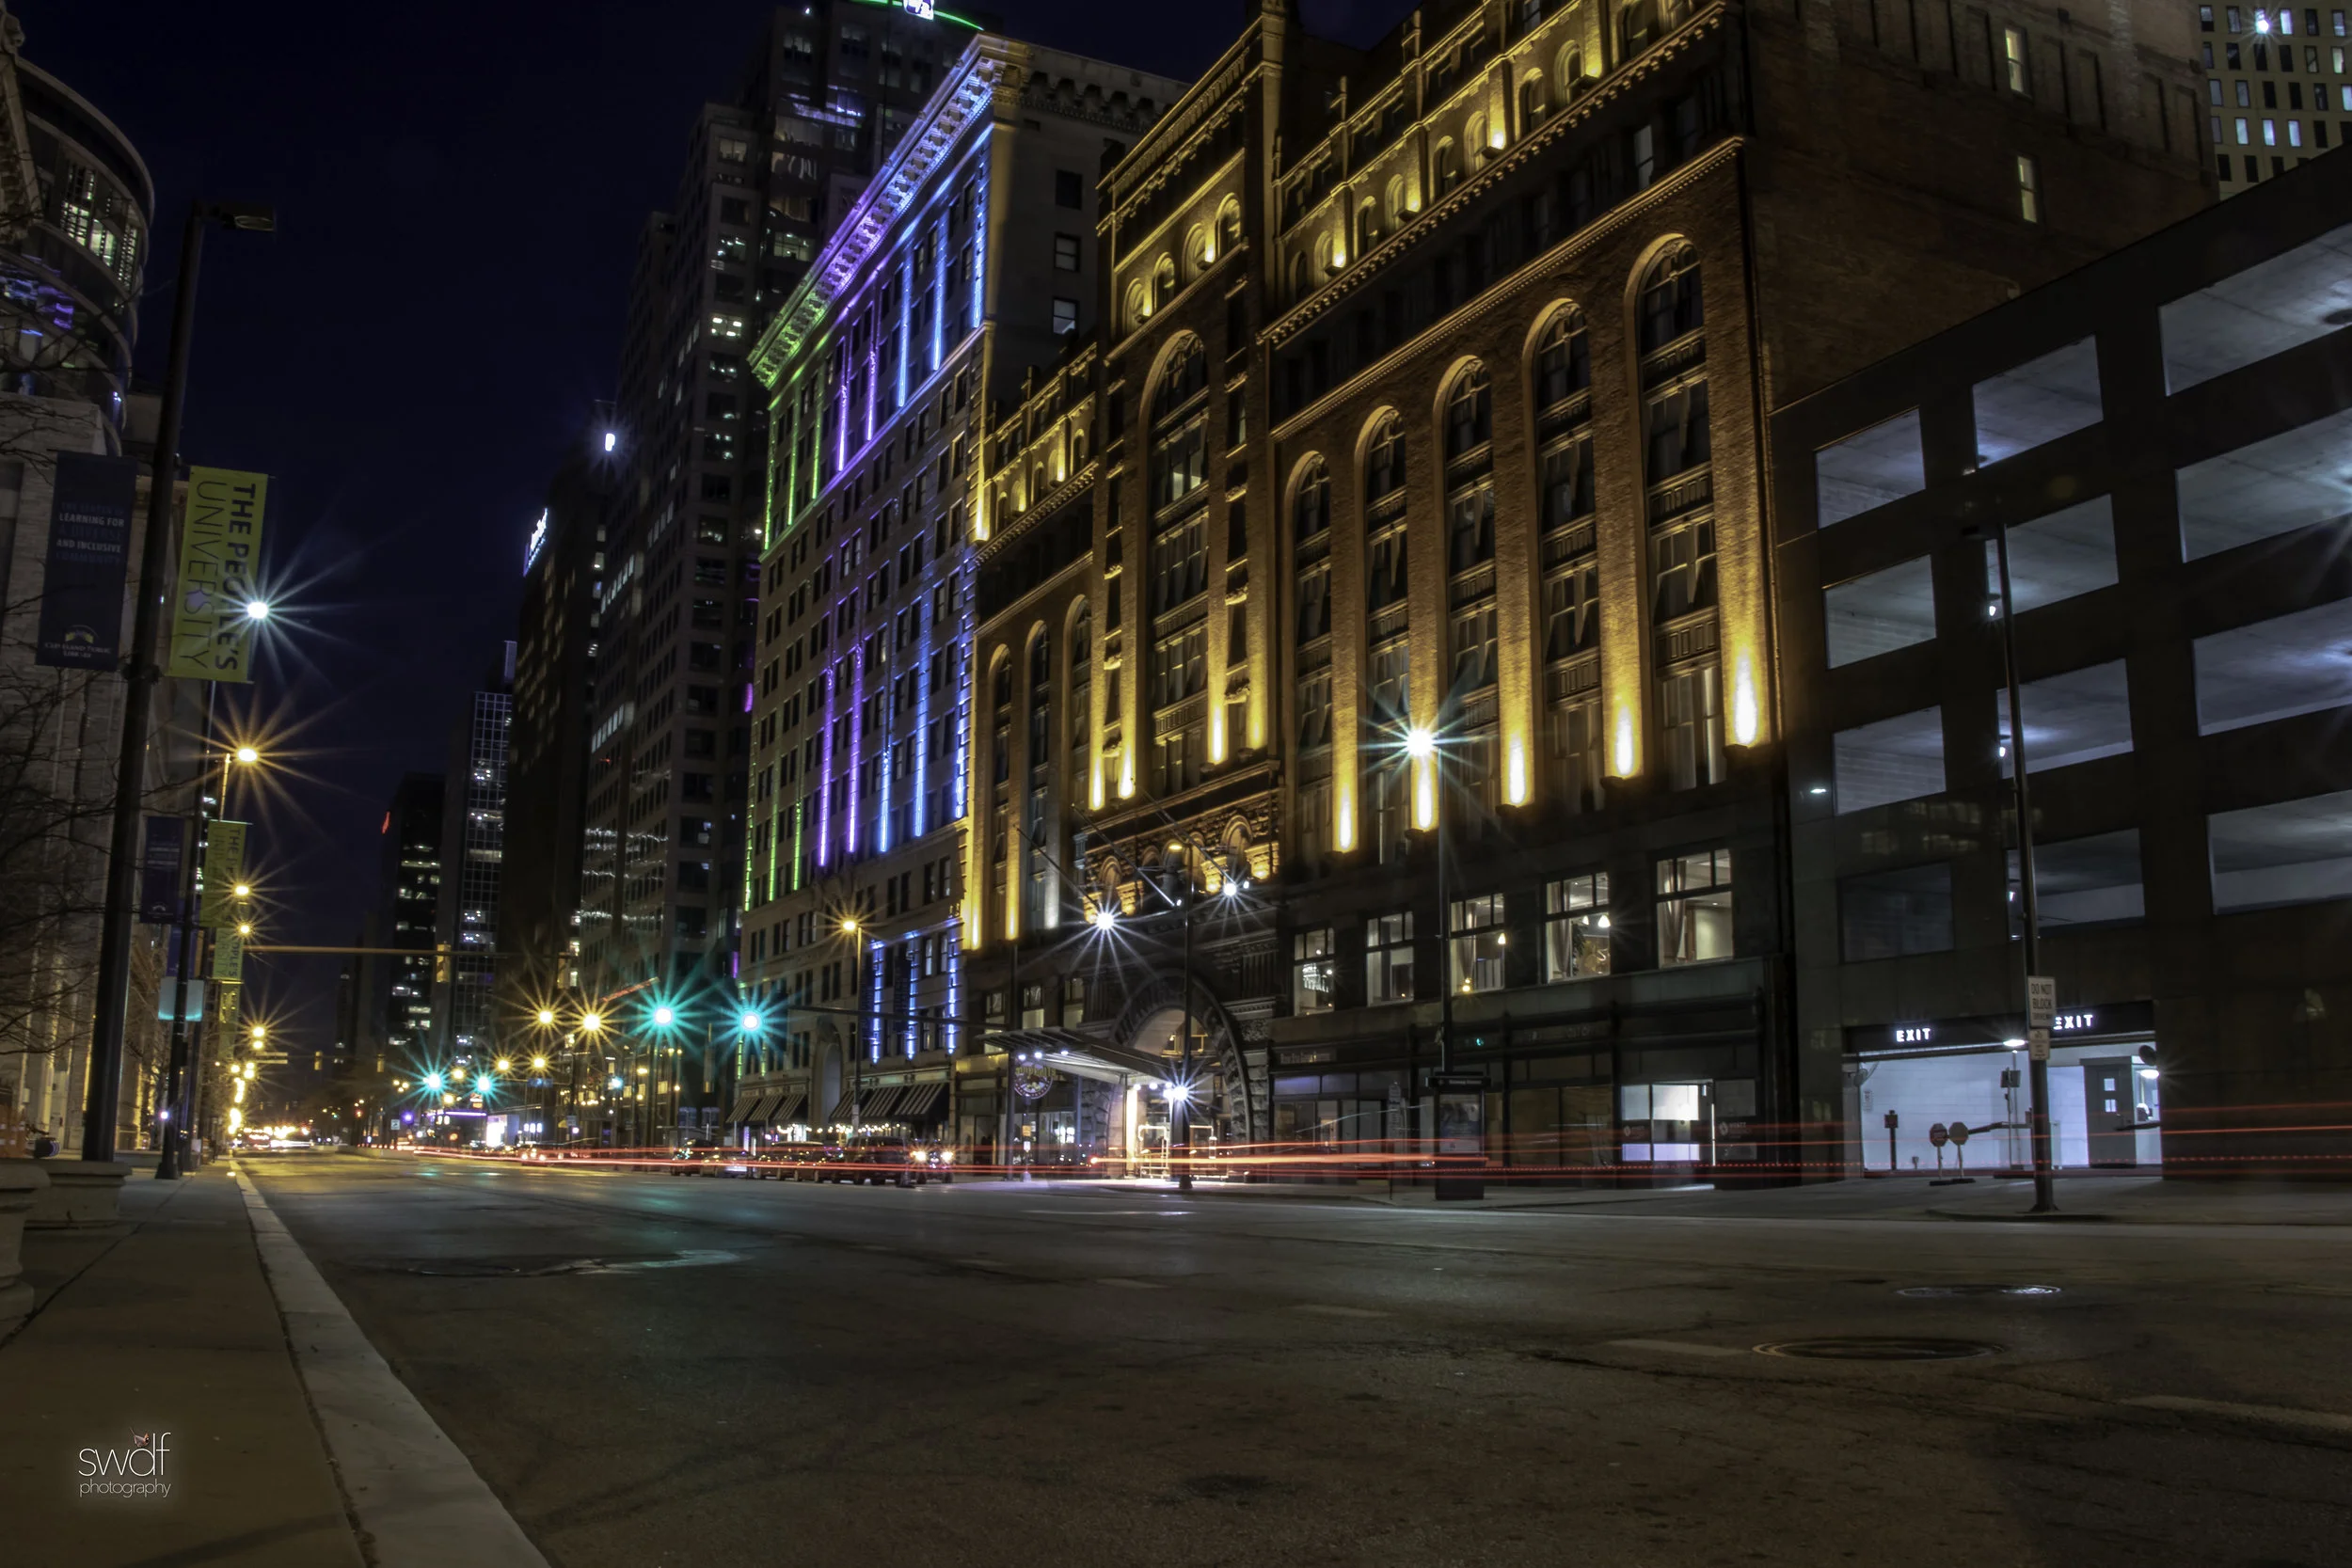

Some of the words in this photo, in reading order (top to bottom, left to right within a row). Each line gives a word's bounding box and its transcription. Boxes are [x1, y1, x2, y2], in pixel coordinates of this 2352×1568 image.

[228, 483, 257, 536] THE
[58, 512, 105, 526] LEARNING
[106, 517, 125, 528] FOR
[56, 538, 76, 548] AND
[76, 540, 121, 554] INCLUSIVE
[179, 479, 228, 670] UNIVERSITY
[215, 541, 249, 672] PEOLE'S
[2031, 982, 2040, 994] DO
[2032, 997, 2053, 1009] BLOCK
[2053, 1014, 2093, 1030] EXIT
[1896, 1027, 1931, 1042] EXIT
